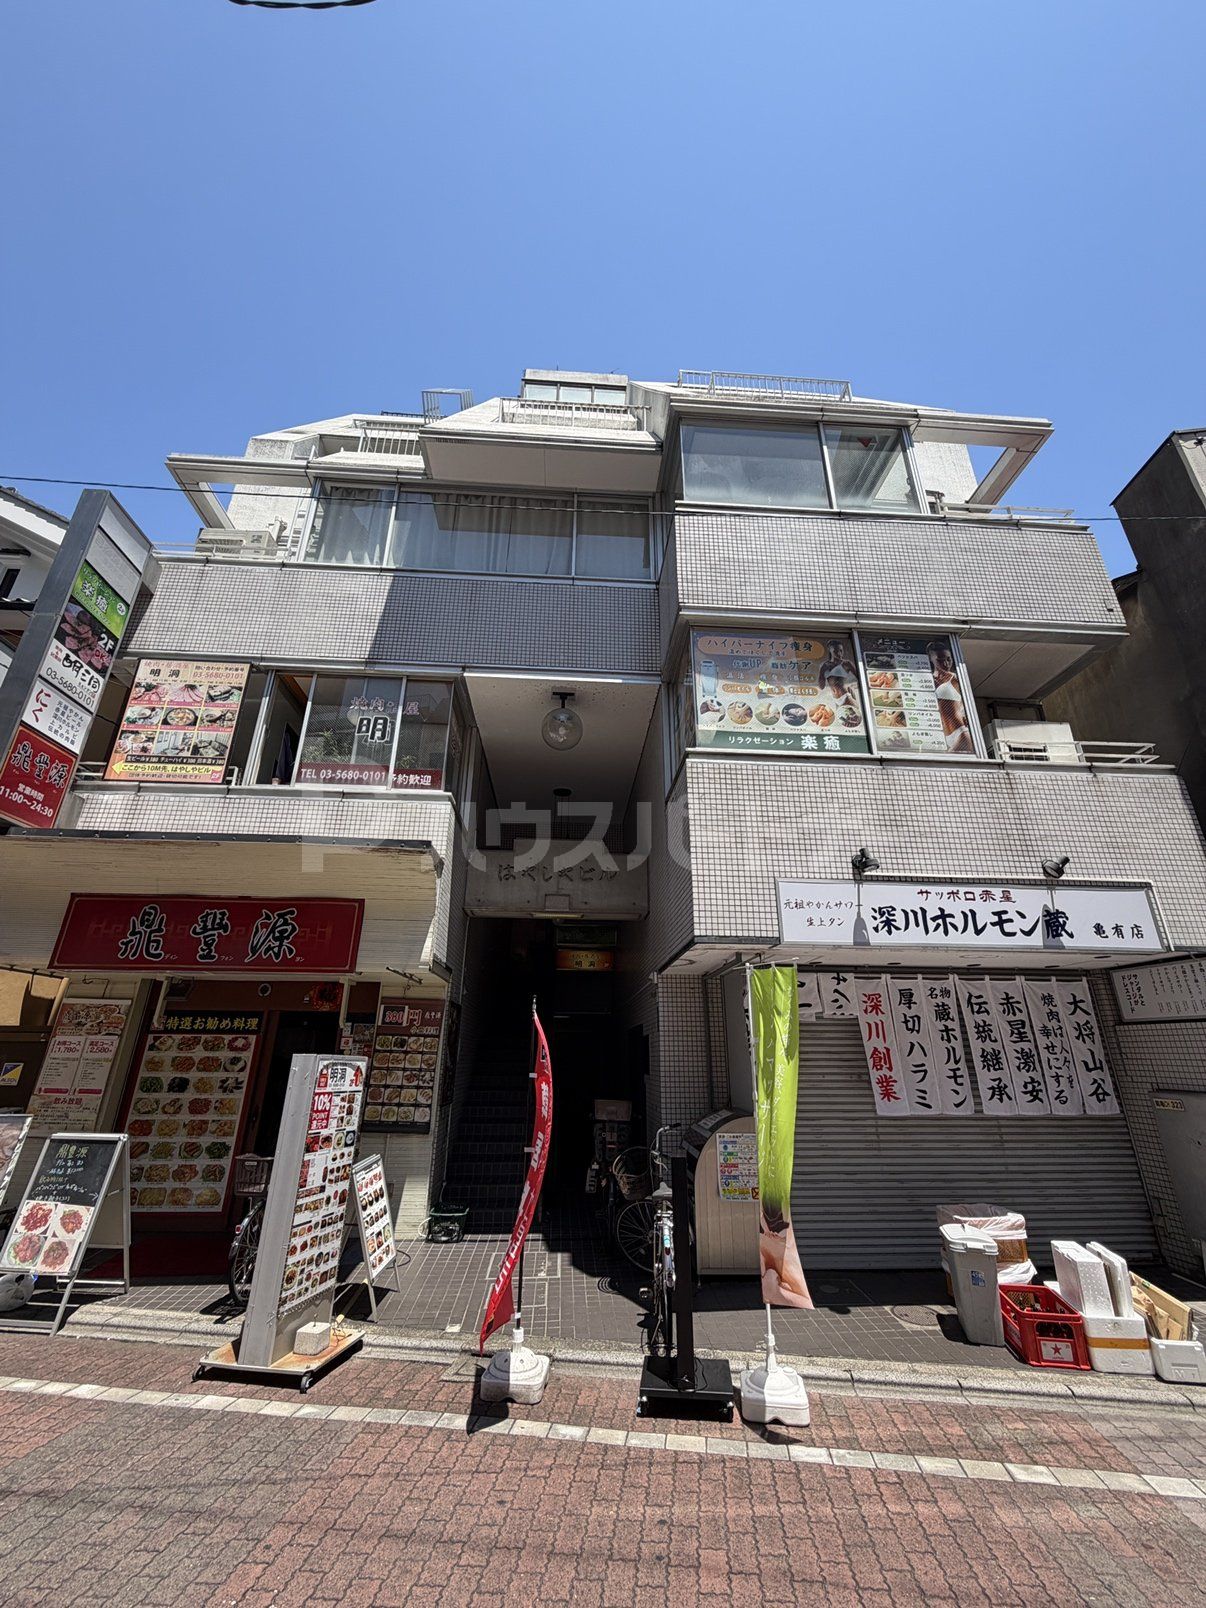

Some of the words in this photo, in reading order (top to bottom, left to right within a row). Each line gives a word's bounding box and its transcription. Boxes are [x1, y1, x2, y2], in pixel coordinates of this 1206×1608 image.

[98, 634, 115, 651] 2F
[192, 671, 244, 680] 03-5680-0101
[45, 667, 96, 709] 03-5680-0101
[31, 688, 52, 723] にく
[727, 735, 795, 746] リラクゼーション
[800, 735, 842, 750] 楽癒
[300, 768, 317, 779] TEL
[319, 769, 387, 781] 03-5680-0101
[497, 864, 619, 882] はやしやビル
[784, 898, 864, 910] 元祖やかんサワー
[916, 889, 1017, 904] サッポロ赤星
[805, 917, 846, 928] 生上タン
[871, 906, 1075, 941] 深川ホルモン蔵
[1092, 922, 1145, 940] 亀有店
[927, 986, 952, 1000] 名物
[165, 1016, 260, 1031] 特選お勧め料理
[860, 991, 902, 1103] 深川創業
[897, 987, 934, 1110] 厚切ハラミ
[933, 1001, 968, 1109] 蔵ホルモン
[966, 994, 1013, 1103] 伝統継承
[998, 992, 1046, 1104] 赤星激安
[1066, 993, 1112, 1104] 大将山谷
[313, 1093, 332, 1111] 10%
[311, 1111, 328, 1120] POINT
